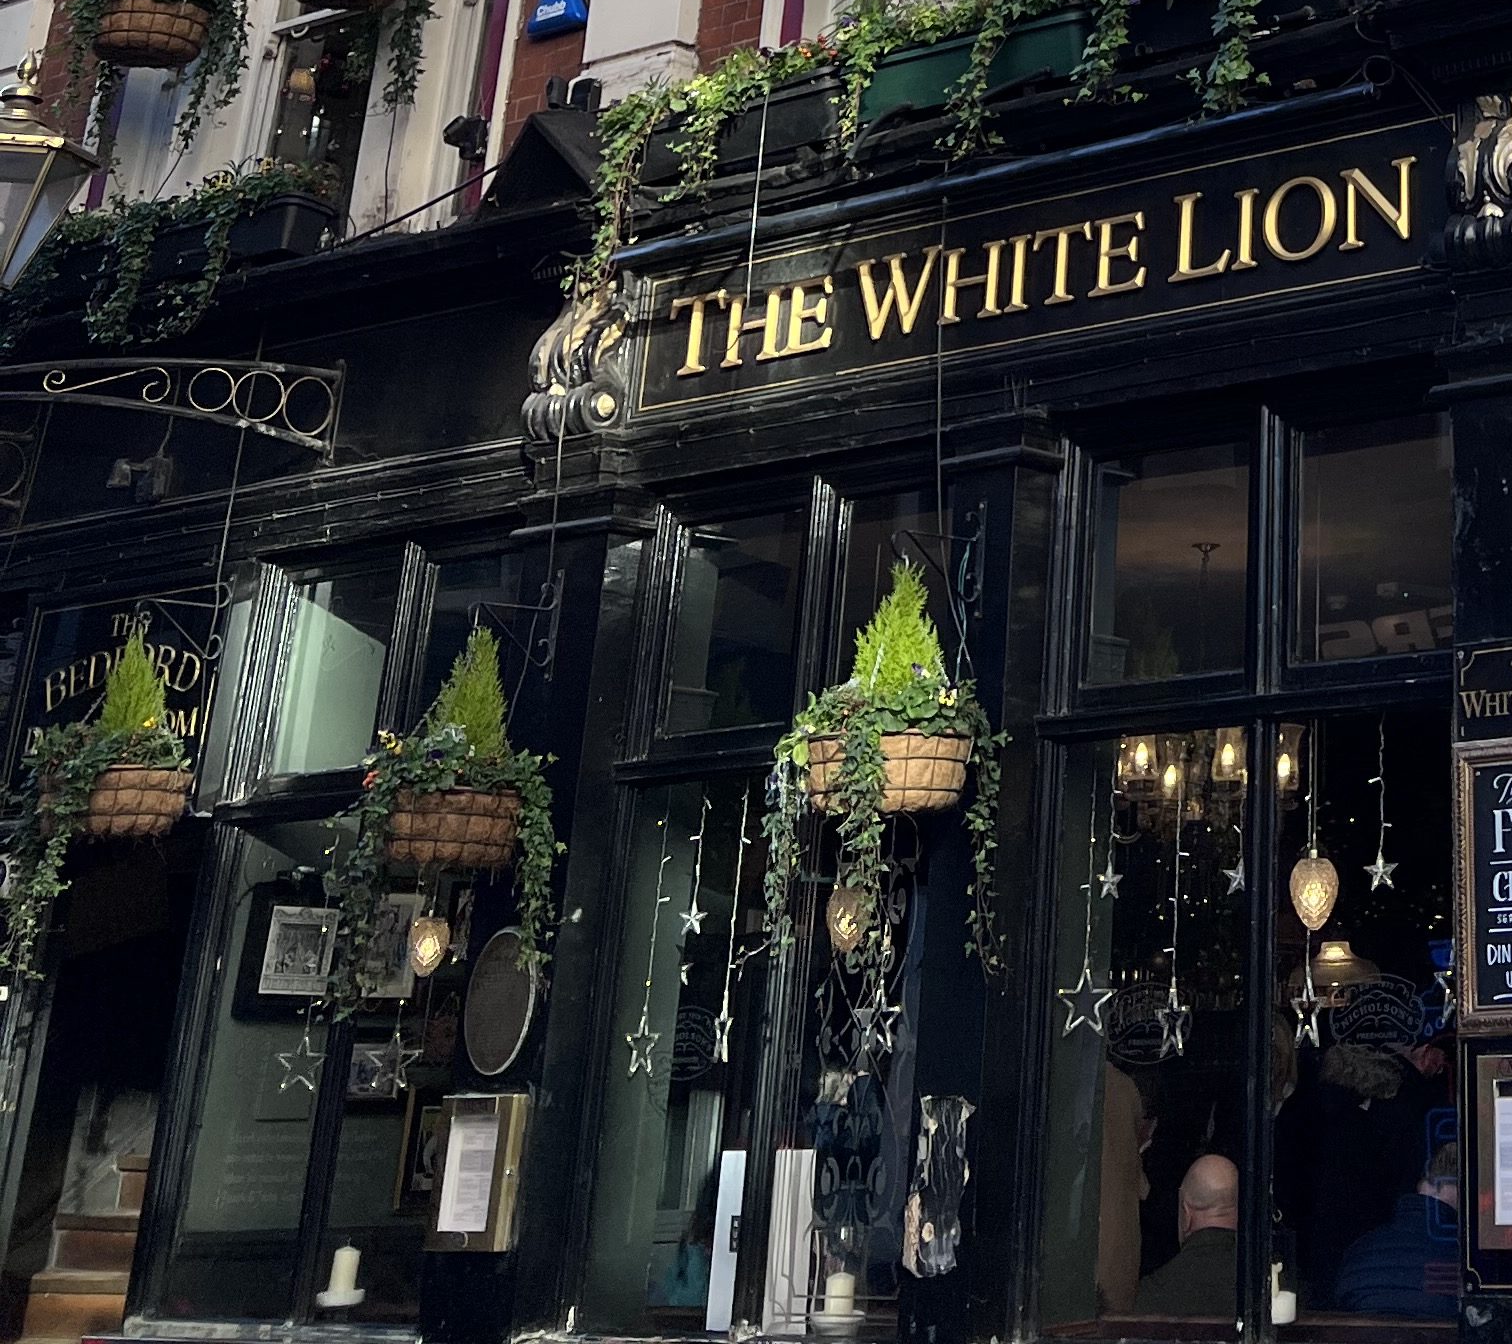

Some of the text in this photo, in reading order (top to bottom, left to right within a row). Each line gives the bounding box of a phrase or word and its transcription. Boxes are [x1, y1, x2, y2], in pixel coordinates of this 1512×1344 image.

[670, 155, 1420, 379] THE WHITE LION
